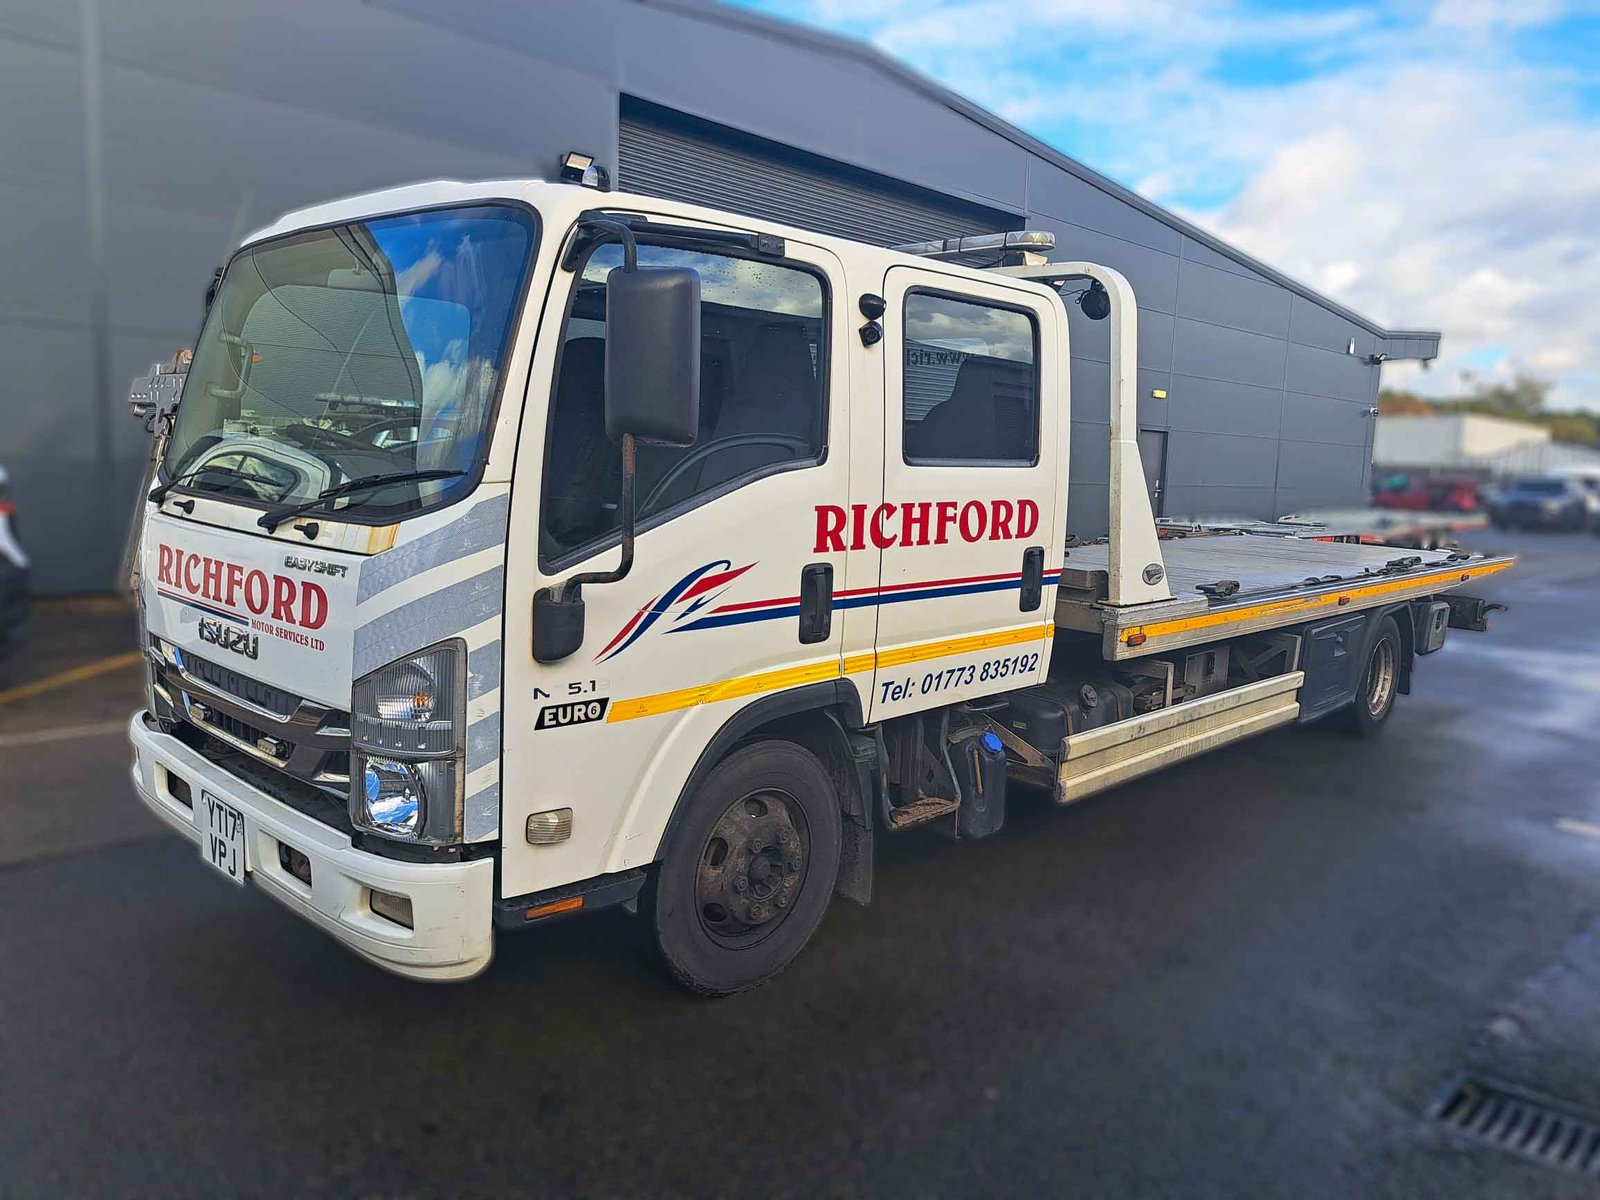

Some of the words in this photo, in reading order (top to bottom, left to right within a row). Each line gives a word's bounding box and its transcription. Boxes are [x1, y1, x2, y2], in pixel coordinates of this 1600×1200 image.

[813, 499, 1039, 553] RICHFORD
[158, 544, 329, 630] RICHFORD
[198, 615, 259, 660] ISUZU
[251, 619, 274, 636] MOTOR
[275, 628, 309, 646] SERVICES
[310, 637, 325, 651] LTD
[881, 677, 916, 703] Tel:
[921, 665, 976, 695] 01773
[979, 652, 1039, 682] 835192
[207, 796, 237, 841] YT17
[209, 832, 236, 876] VPJ
